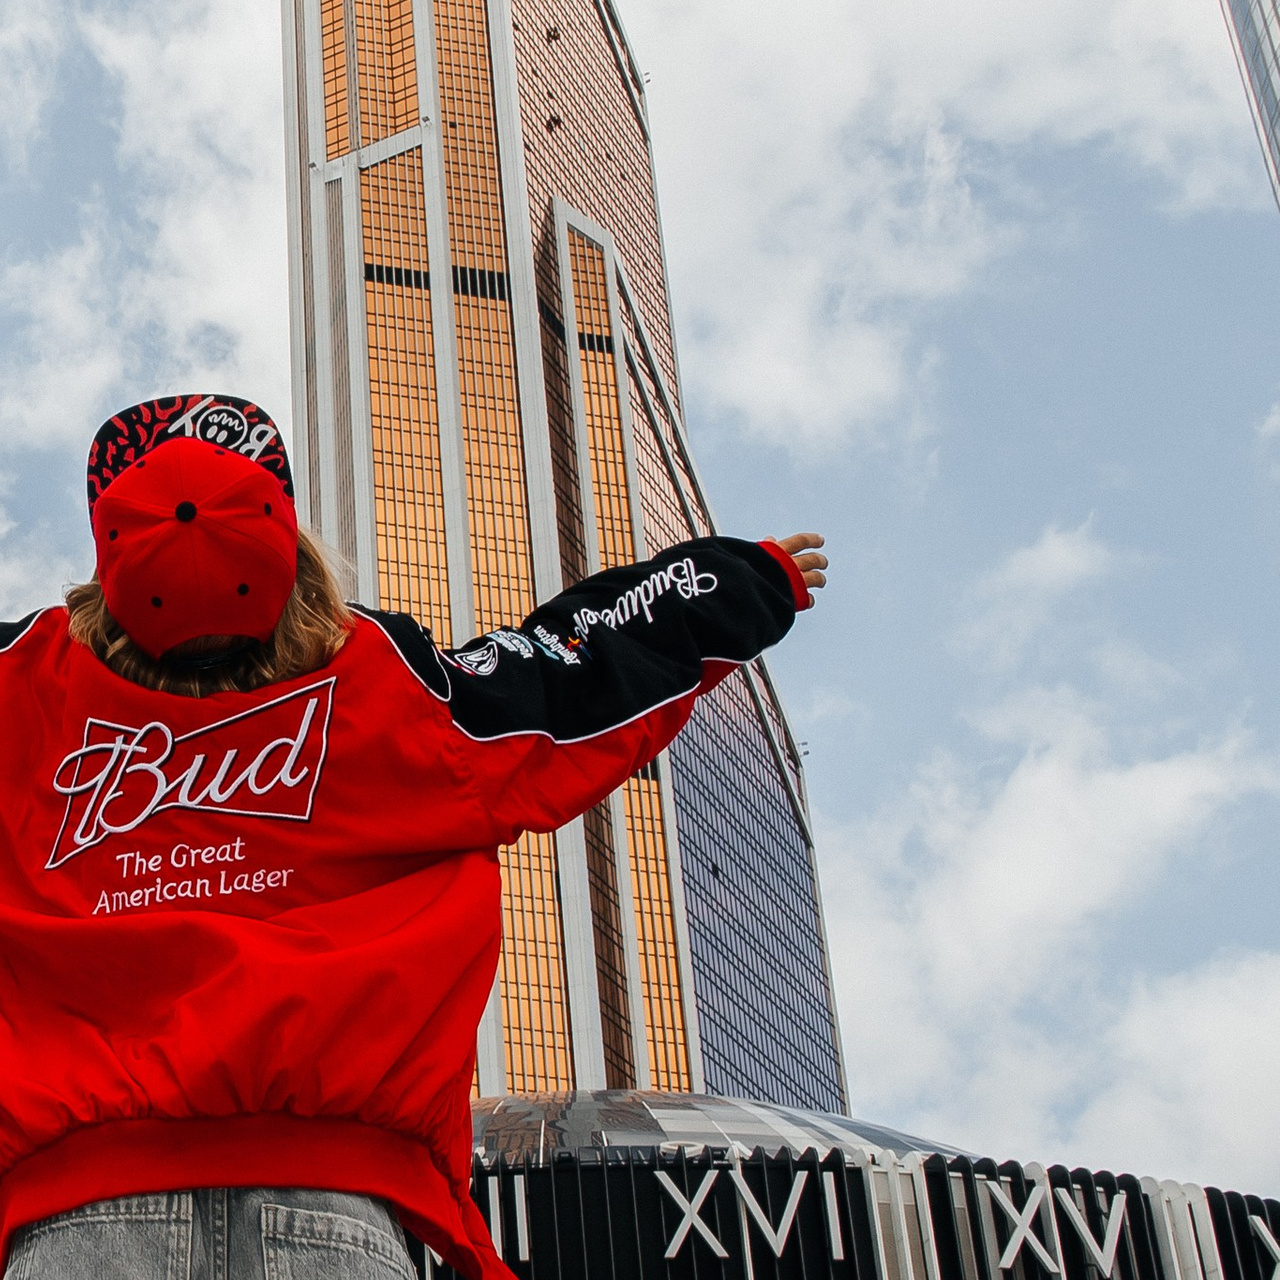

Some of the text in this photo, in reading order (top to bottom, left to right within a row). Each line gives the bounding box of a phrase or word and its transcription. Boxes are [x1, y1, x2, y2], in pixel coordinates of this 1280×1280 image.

[573, 557, 718, 643] Budweer
[53, 697, 318, 845] Bud
[116, 837, 245, 877] The Great
[92, 869, 294, 915] American Lager
